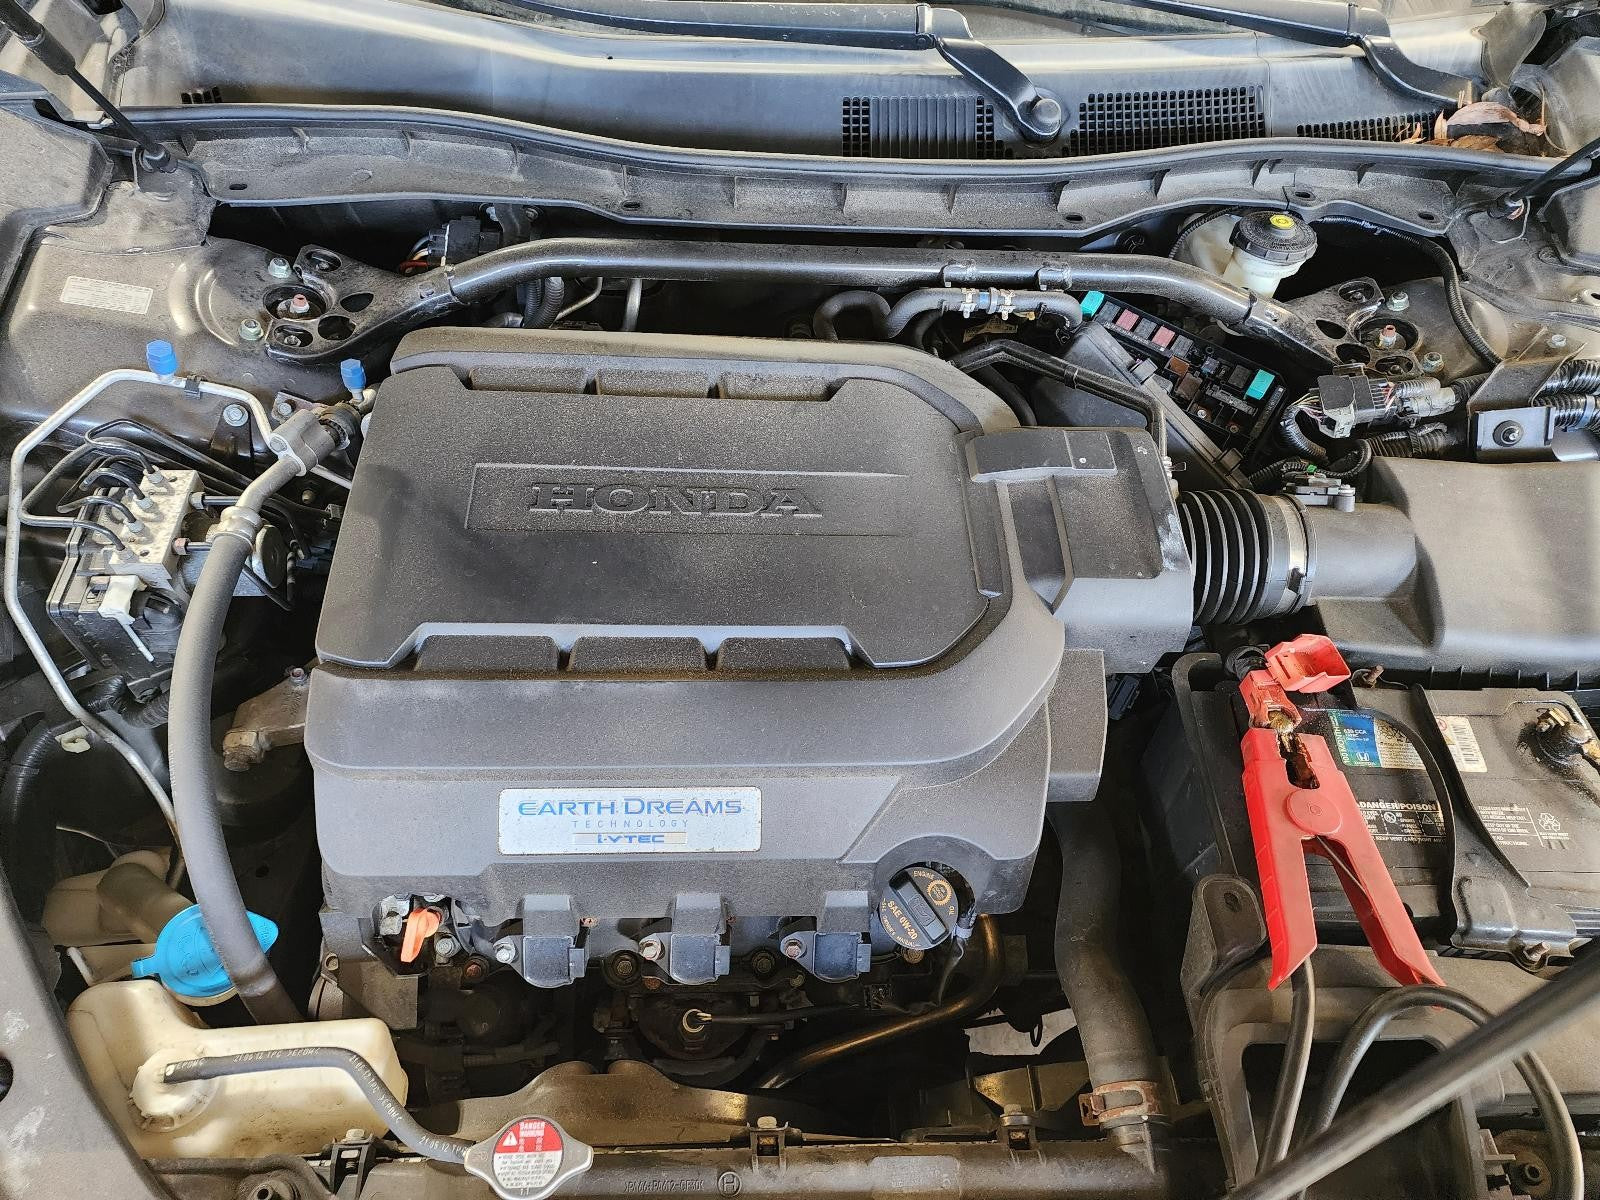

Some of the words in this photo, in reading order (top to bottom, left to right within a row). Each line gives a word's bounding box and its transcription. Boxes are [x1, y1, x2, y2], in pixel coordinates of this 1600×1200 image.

[529, 482, 823, 518] HONDA
[518, 800, 615, 815] EARTH
[623, 798, 742, 815] DREAMS
[1359, 801, 1437, 811] DANGER/POISON
[571, 819, 689, 828] TECHNOLOGY
[887, 900, 902, 918] SAE
[899, 915, 918, 940] 0W-20
